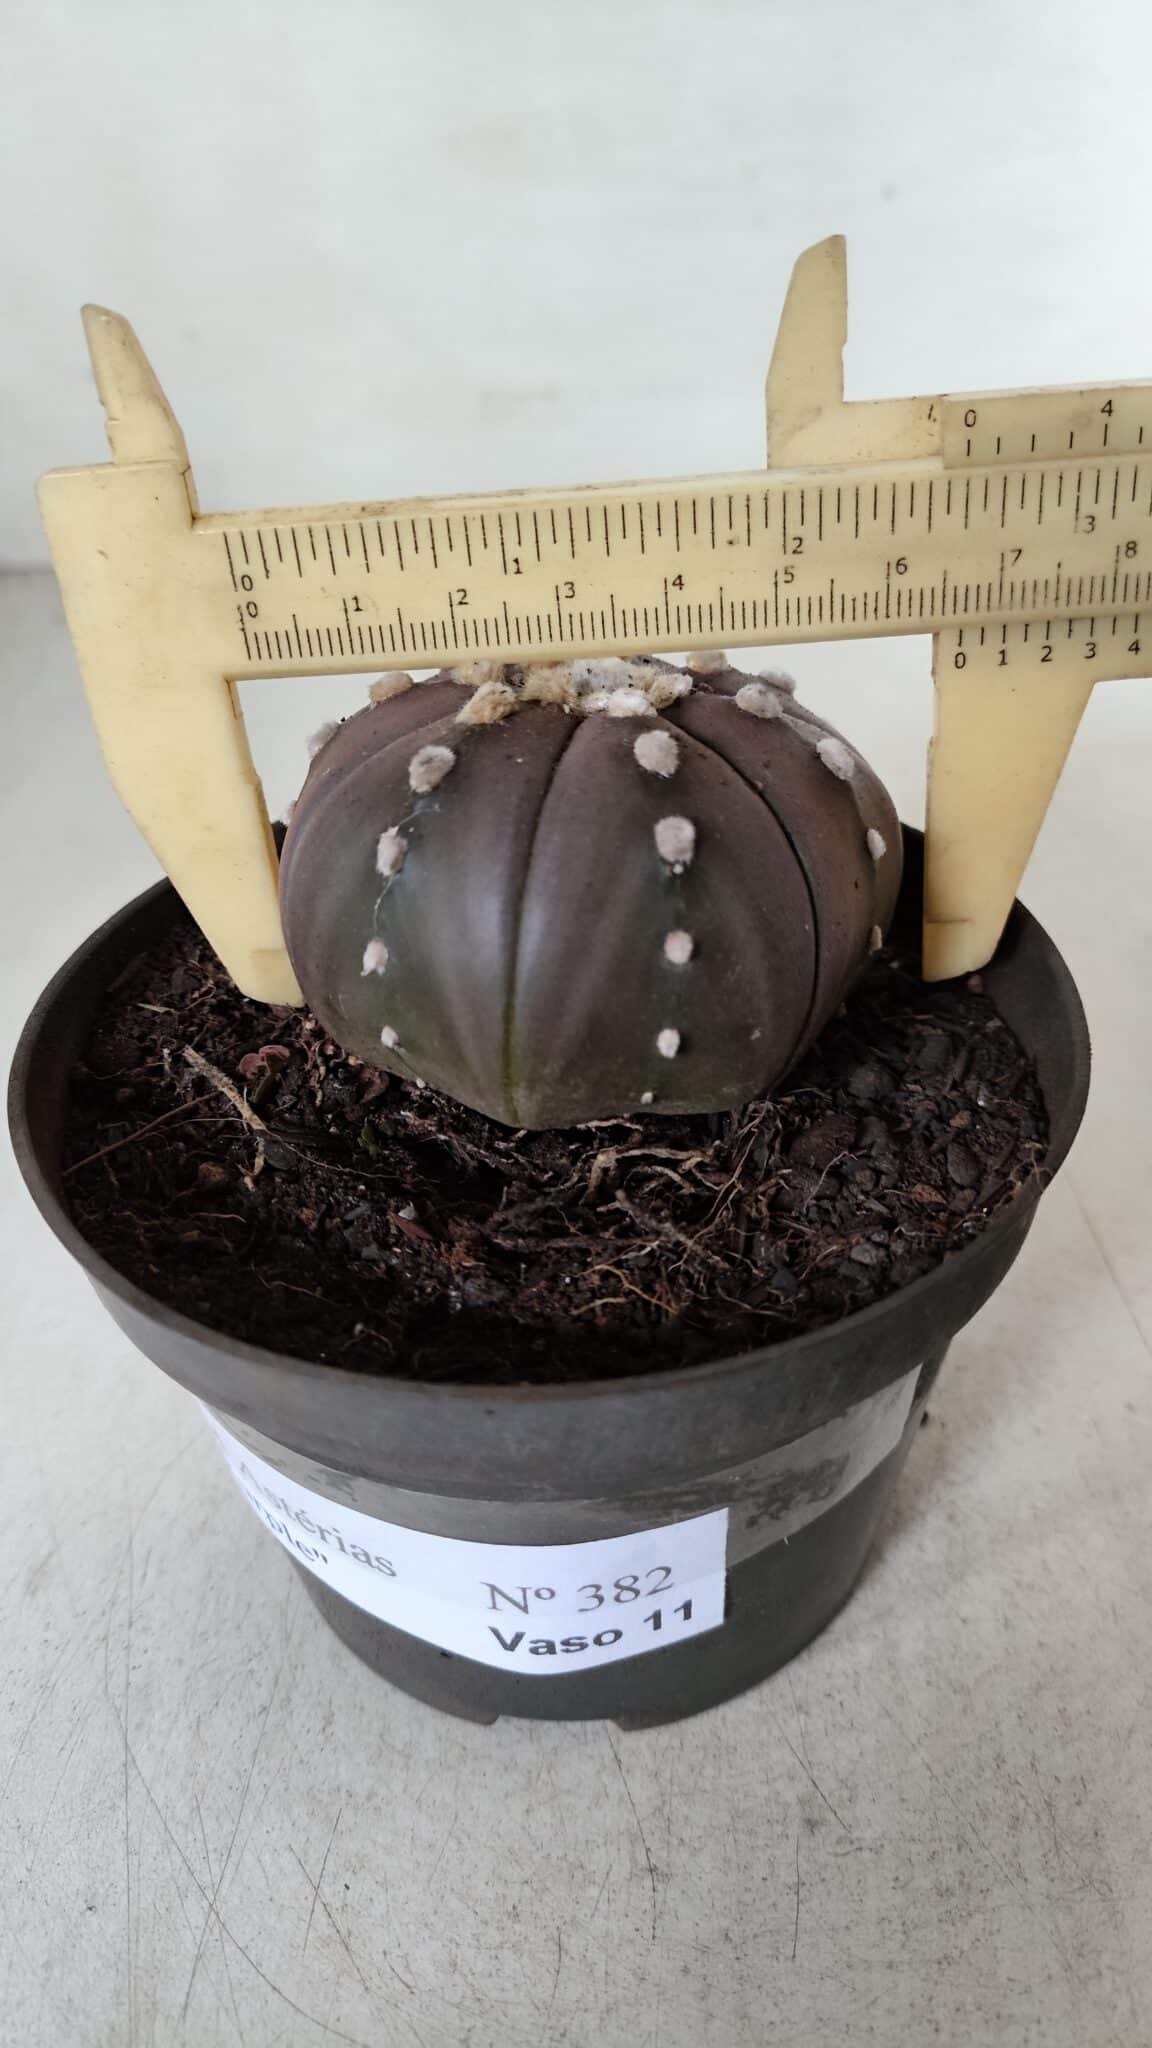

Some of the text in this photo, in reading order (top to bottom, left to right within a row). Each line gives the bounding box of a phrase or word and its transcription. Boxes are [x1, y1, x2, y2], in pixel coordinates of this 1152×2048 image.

[964, 399, 1113, 427] 0 4
[241, 515, 1096, 591] 0 1 2 3
[246, 540, 1138, 618] 0 1 2 3 4 5 6 7 8
[954, 639, 1140, 669] 0 1 2 3 4
[577, 1565, 676, 1612] 382
[488, 1599, 693, 1656] Vaso 11
